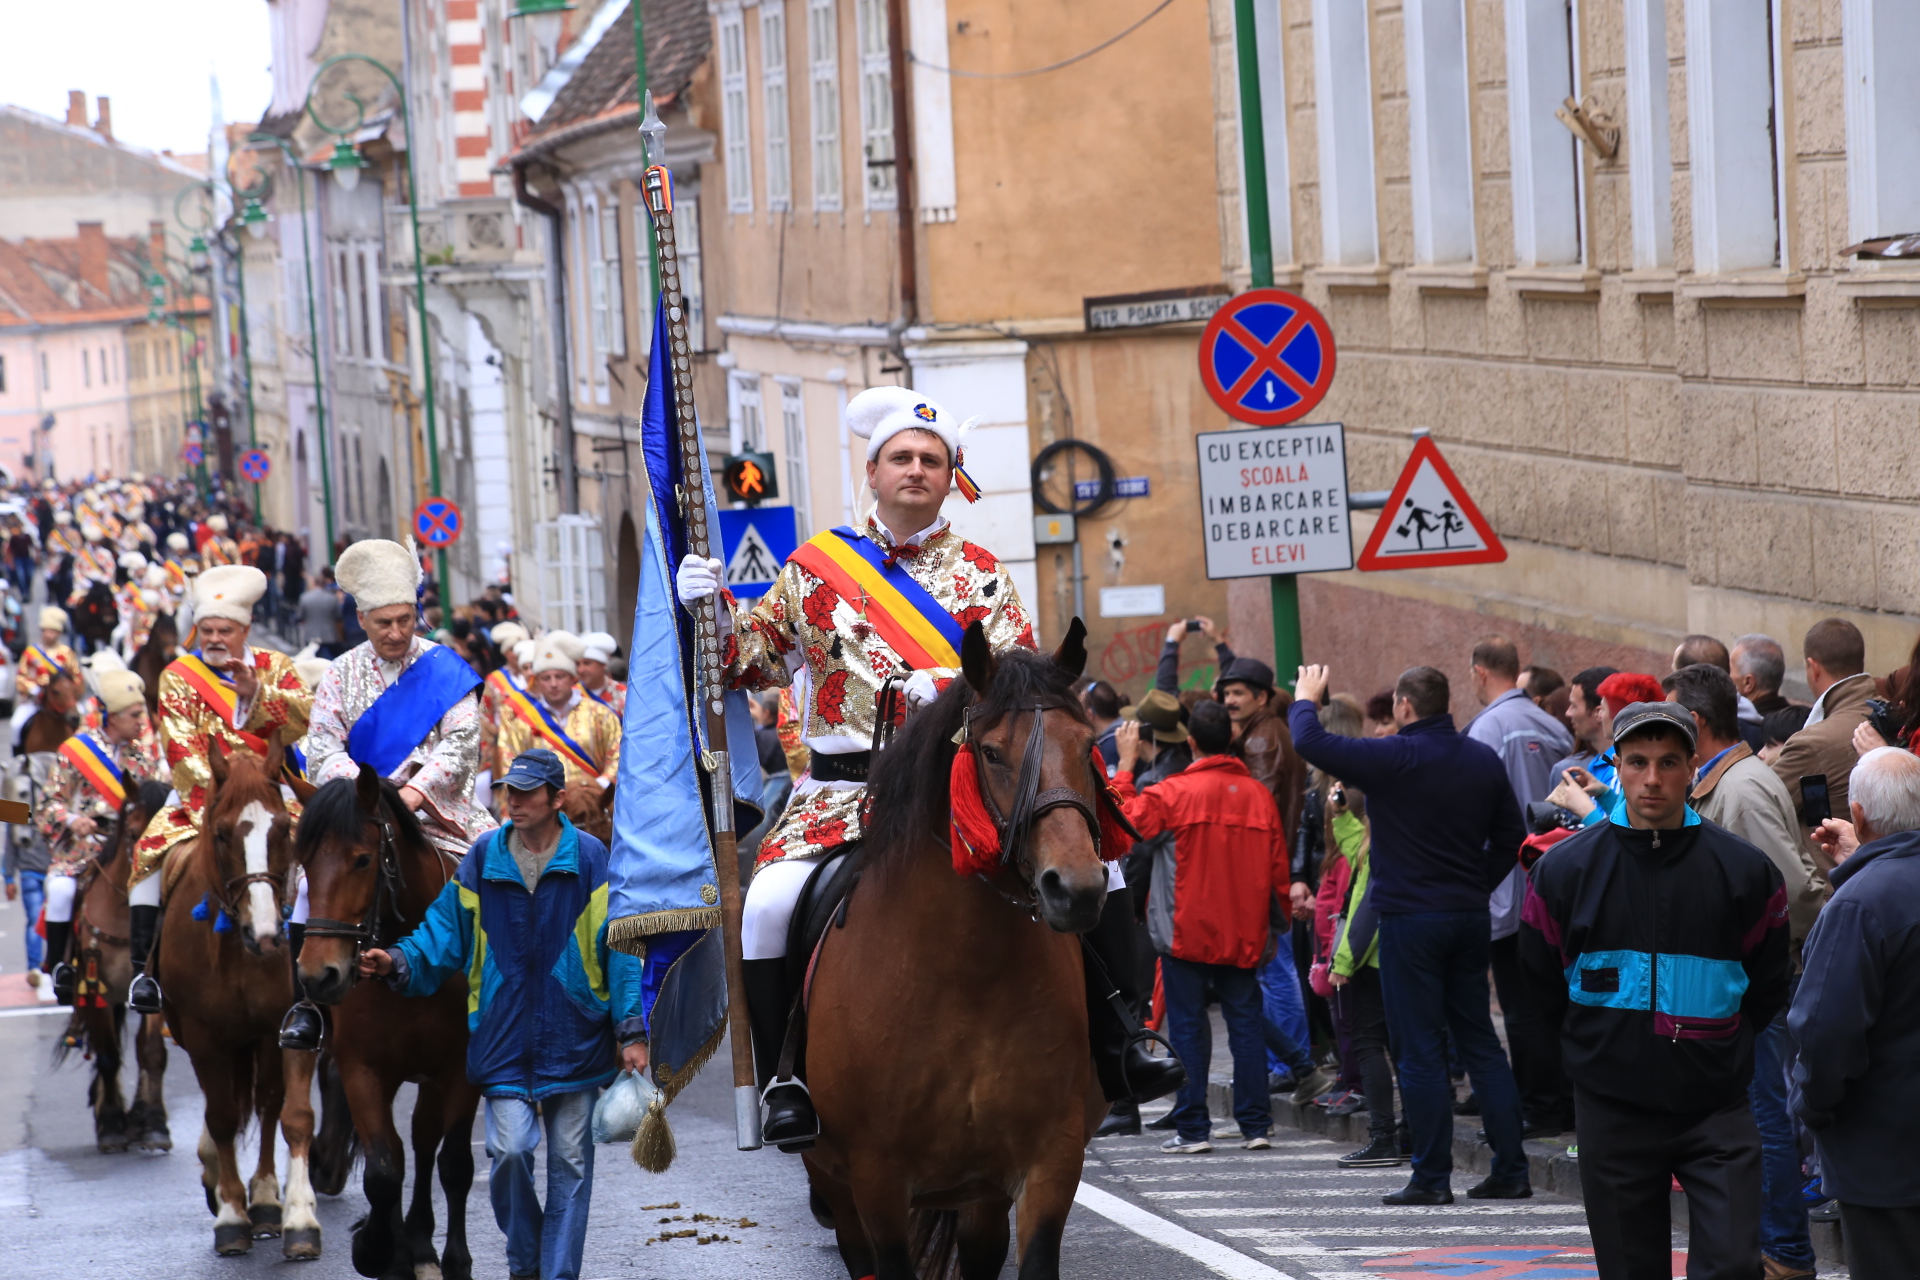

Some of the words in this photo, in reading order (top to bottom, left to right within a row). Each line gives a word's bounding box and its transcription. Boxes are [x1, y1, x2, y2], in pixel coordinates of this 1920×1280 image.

[1128, 303, 1180, 322] POARTA
[1208, 443, 1230, 463] CU
[1238, 435, 1335, 460] EXCEPTIA
[1211, 515, 1340, 543] DEBARCARE
[1251, 543, 1306, 565] ELEVI
